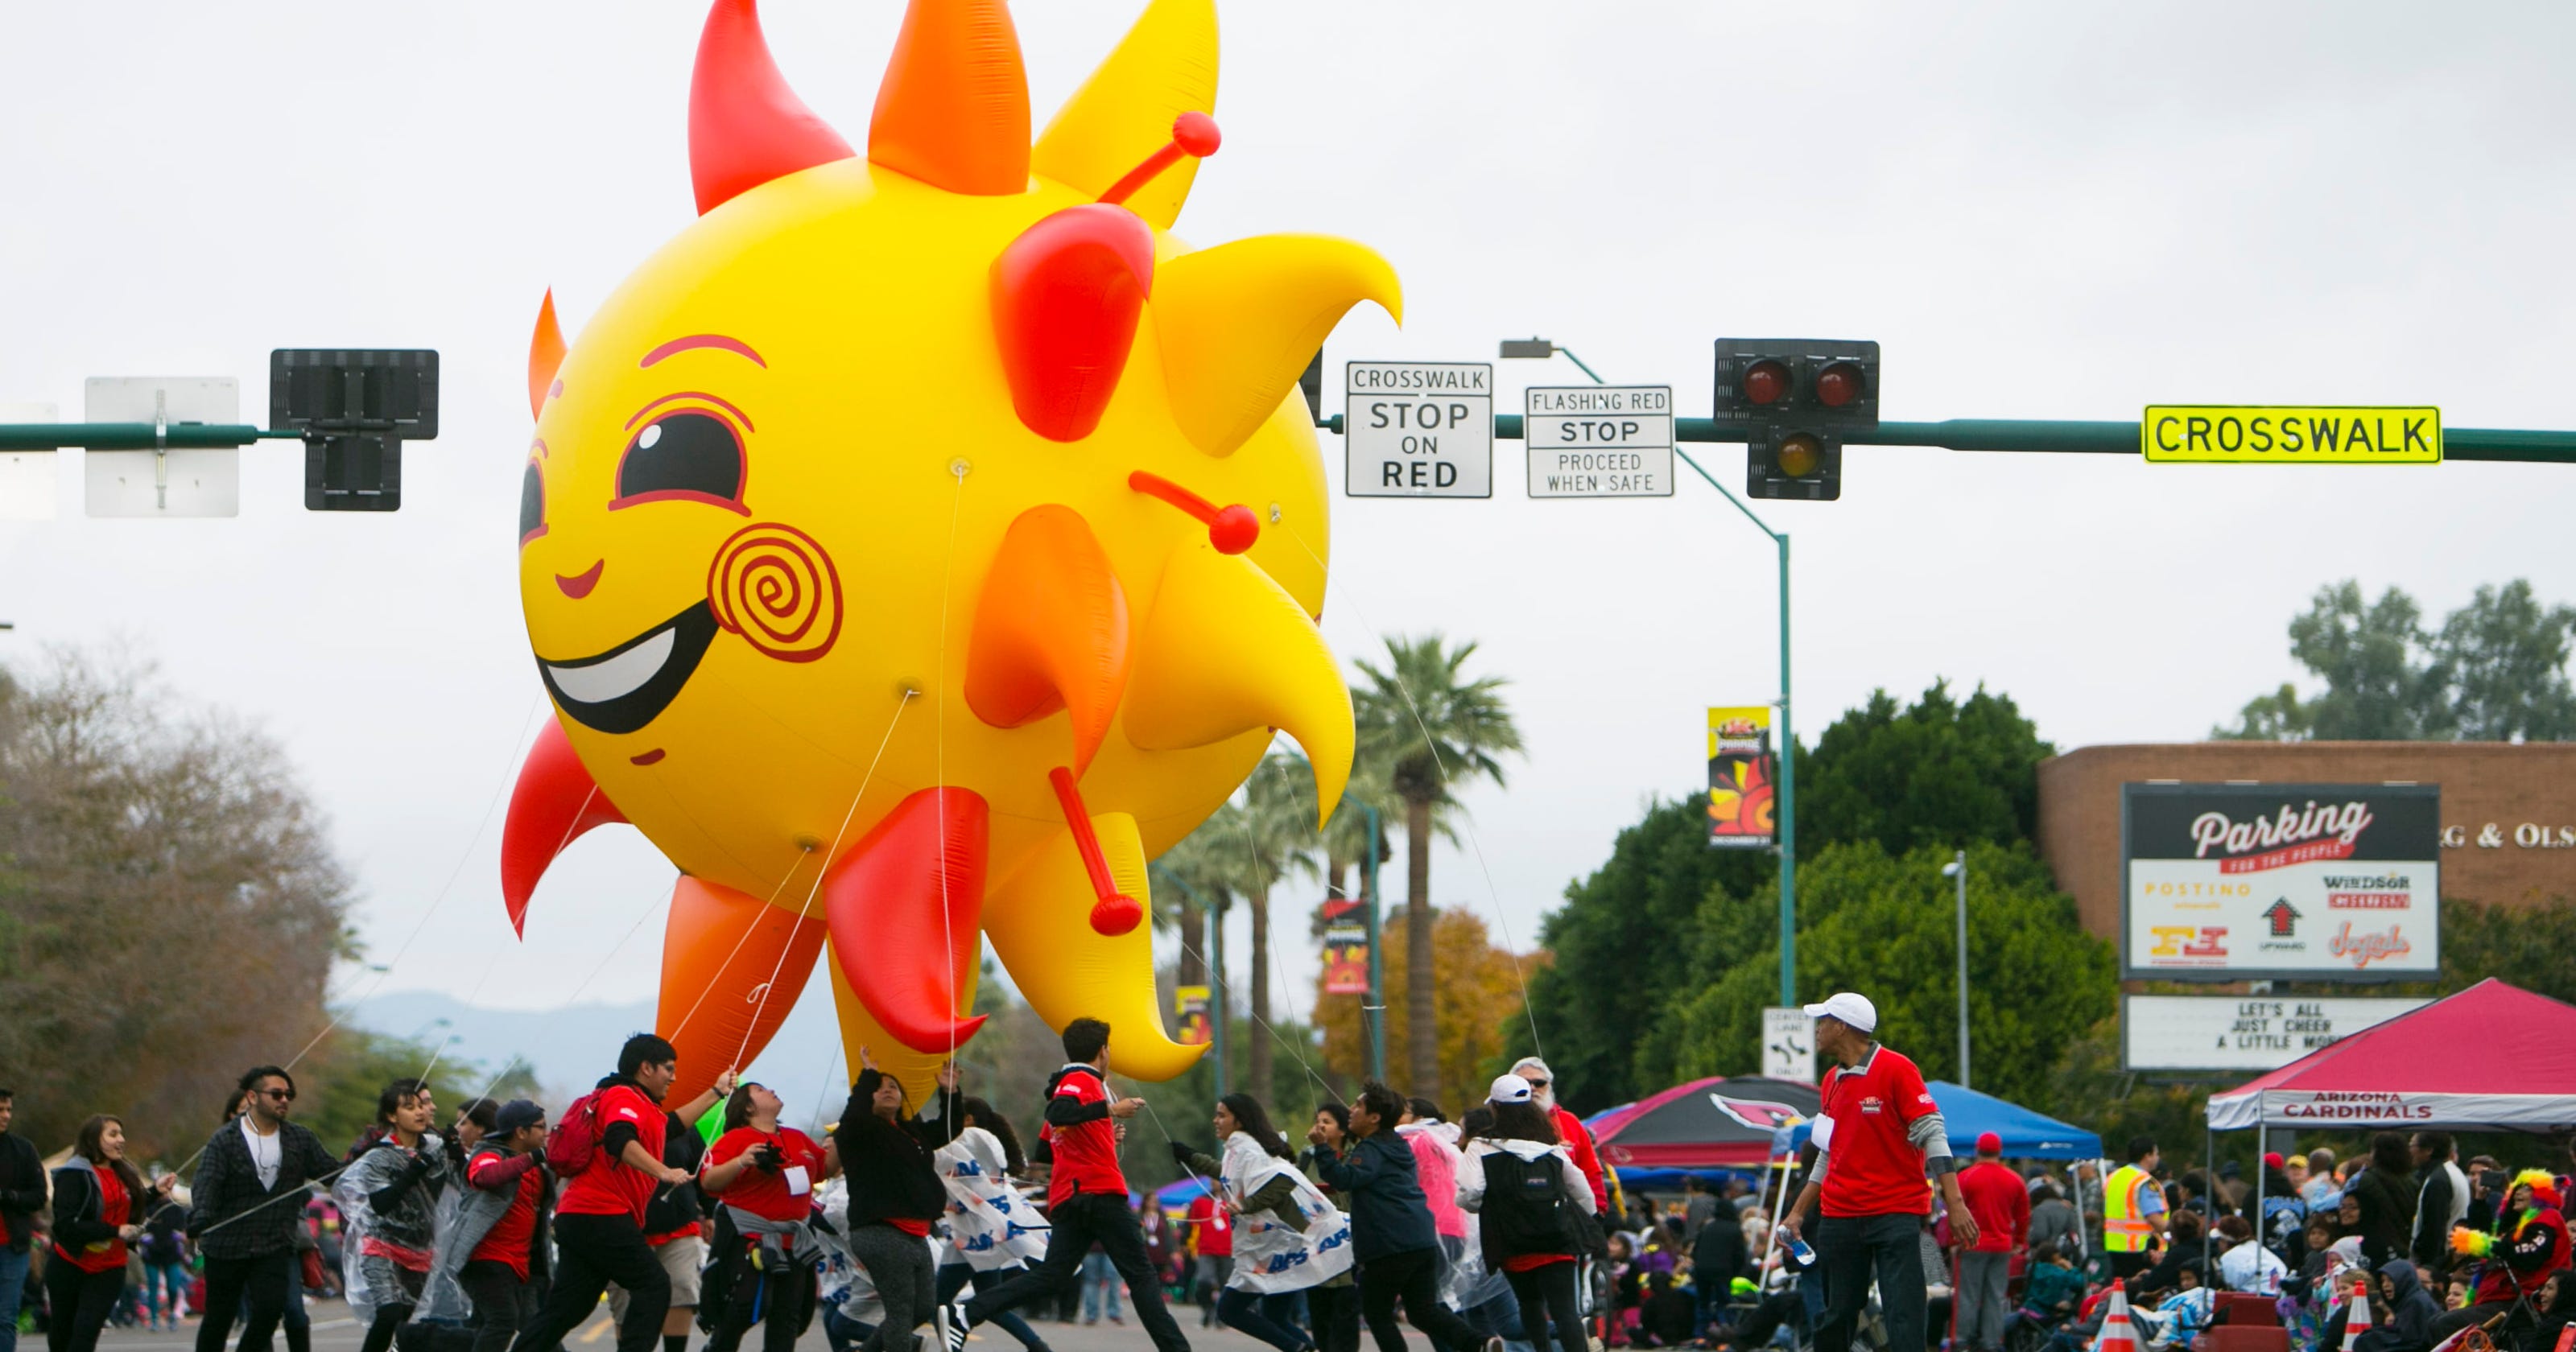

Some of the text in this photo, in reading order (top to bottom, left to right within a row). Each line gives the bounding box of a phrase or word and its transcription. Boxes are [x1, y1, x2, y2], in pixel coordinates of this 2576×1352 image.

[1354, 369, 1484, 389] CROSSWALK
[1533, 393, 1666, 410] FLASHING RED
[1370, 402, 1469, 430] STOP
[1560, 421, 1640, 442] STOP
[2156, 416, 2429, 452] CROSSWALK
[1401, 435, 1438, 455] ON
[1558, 454, 1641, 471] PROCEED
[1382, 461, 1458, 488] RED
[1547, 474, 1654, 492] WHEN SAFE
[2190, 800, 2374, 859] Parking
[2477, 822, 2504, 848] &
[2229, 843, 2342, 873] FOR THE PEOPLE
[2144, 882, 2252, 897] POSTINO
[2238, 1002, 2323, 1017] LET'S ALL
[2231, 1018, 2332, 1032] JUST CHEER
[2217, 1034, 2345, 1049] A LITTLE MOR
[2314, 1092, 2402, 1103] ARIZONA
[2283, 1103, 2433, 1119] CARDINALS
